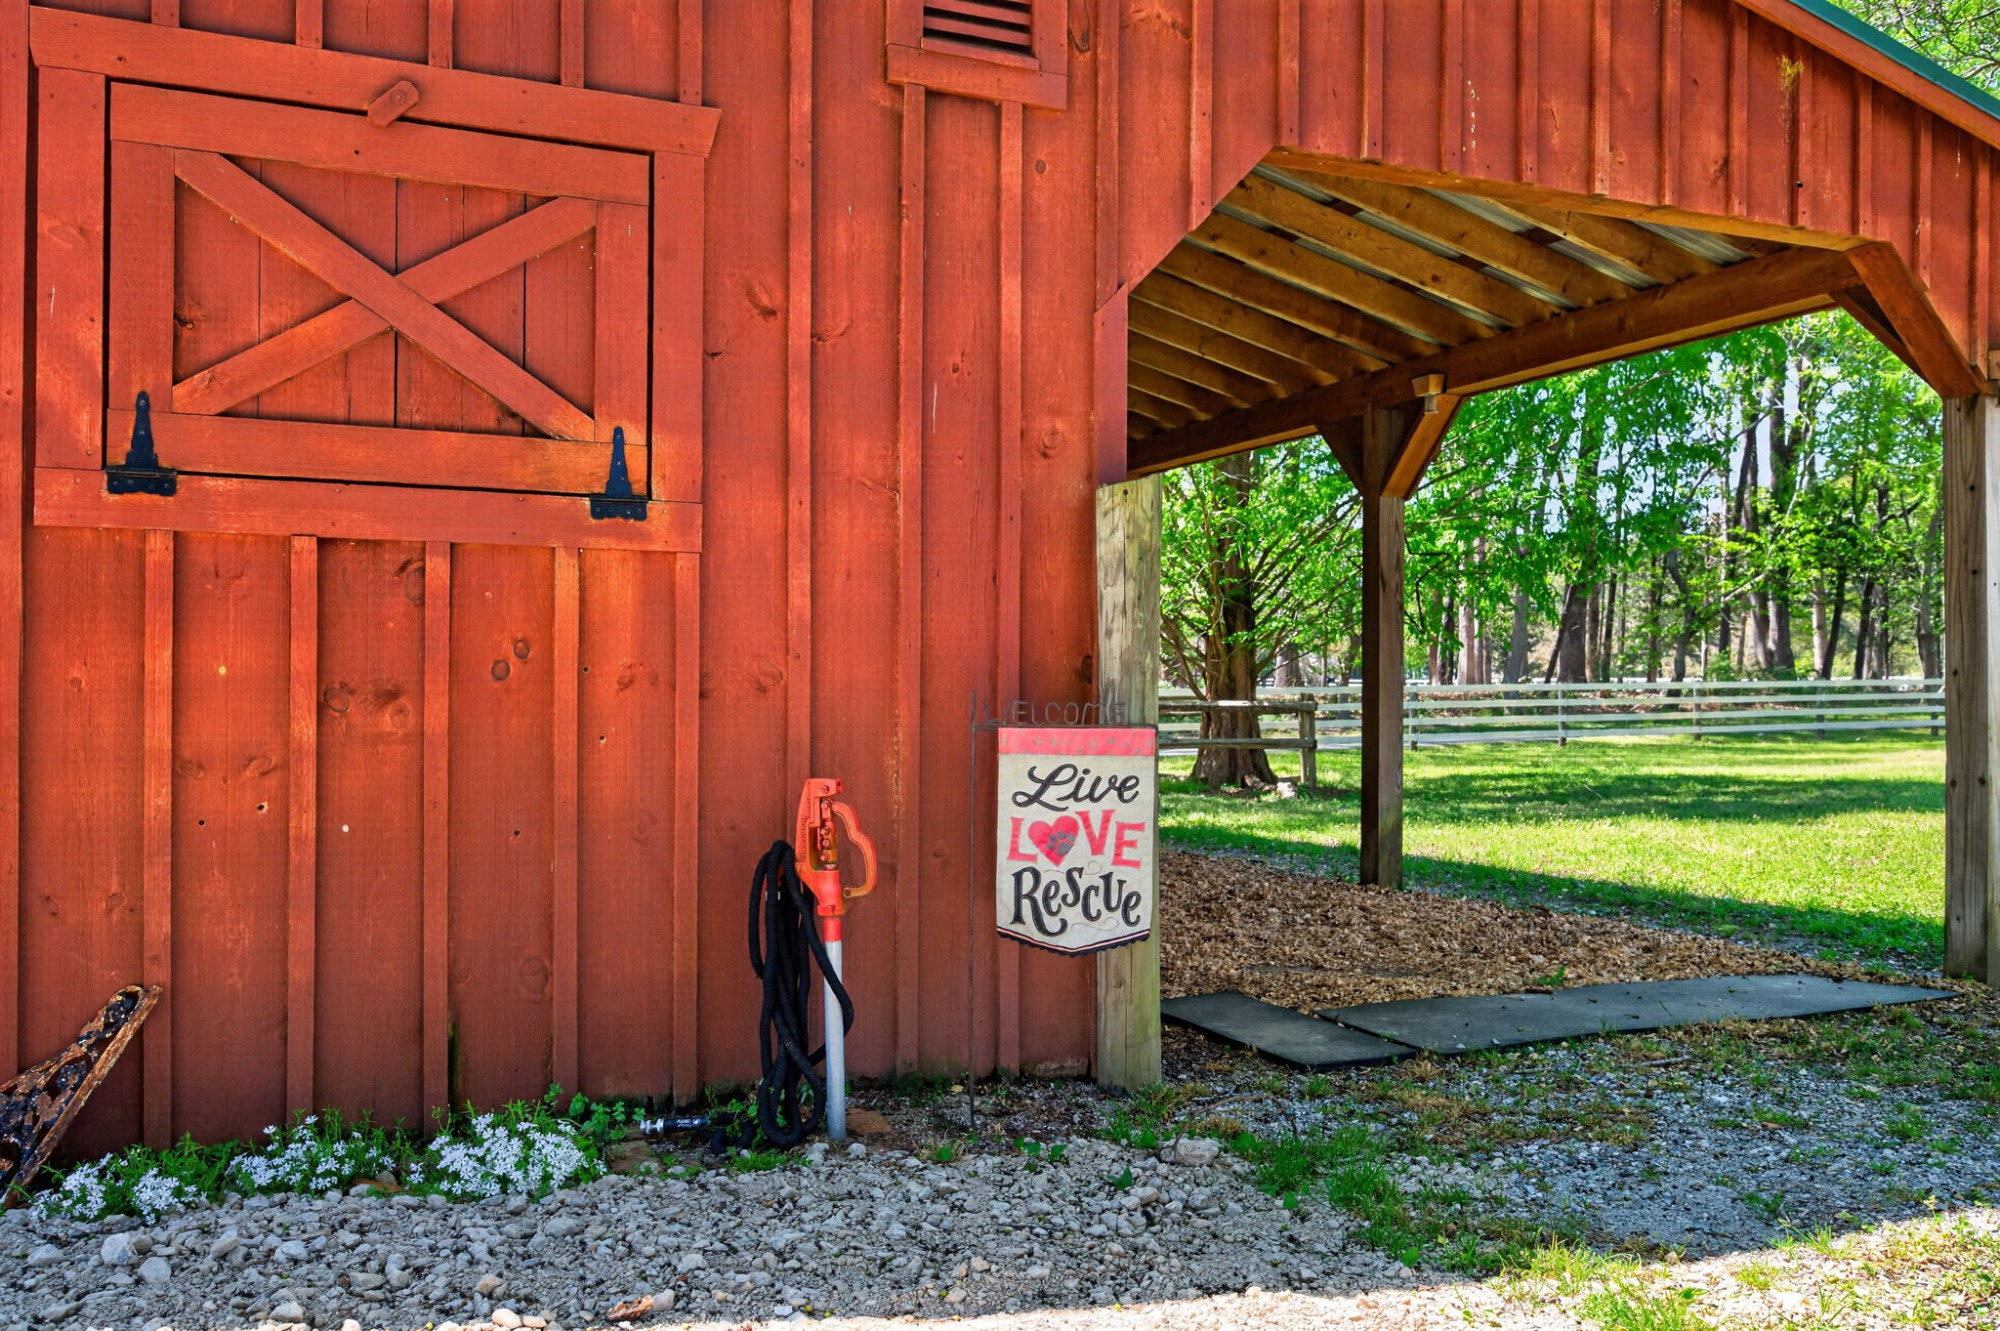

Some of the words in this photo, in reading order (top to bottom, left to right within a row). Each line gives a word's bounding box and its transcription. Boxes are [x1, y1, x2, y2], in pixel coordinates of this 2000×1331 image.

[983, 701, 1128, 726] WELCOME
[1011, 763, 1140, 812] Live
[1009, 865, 1142, 937] Rescue
